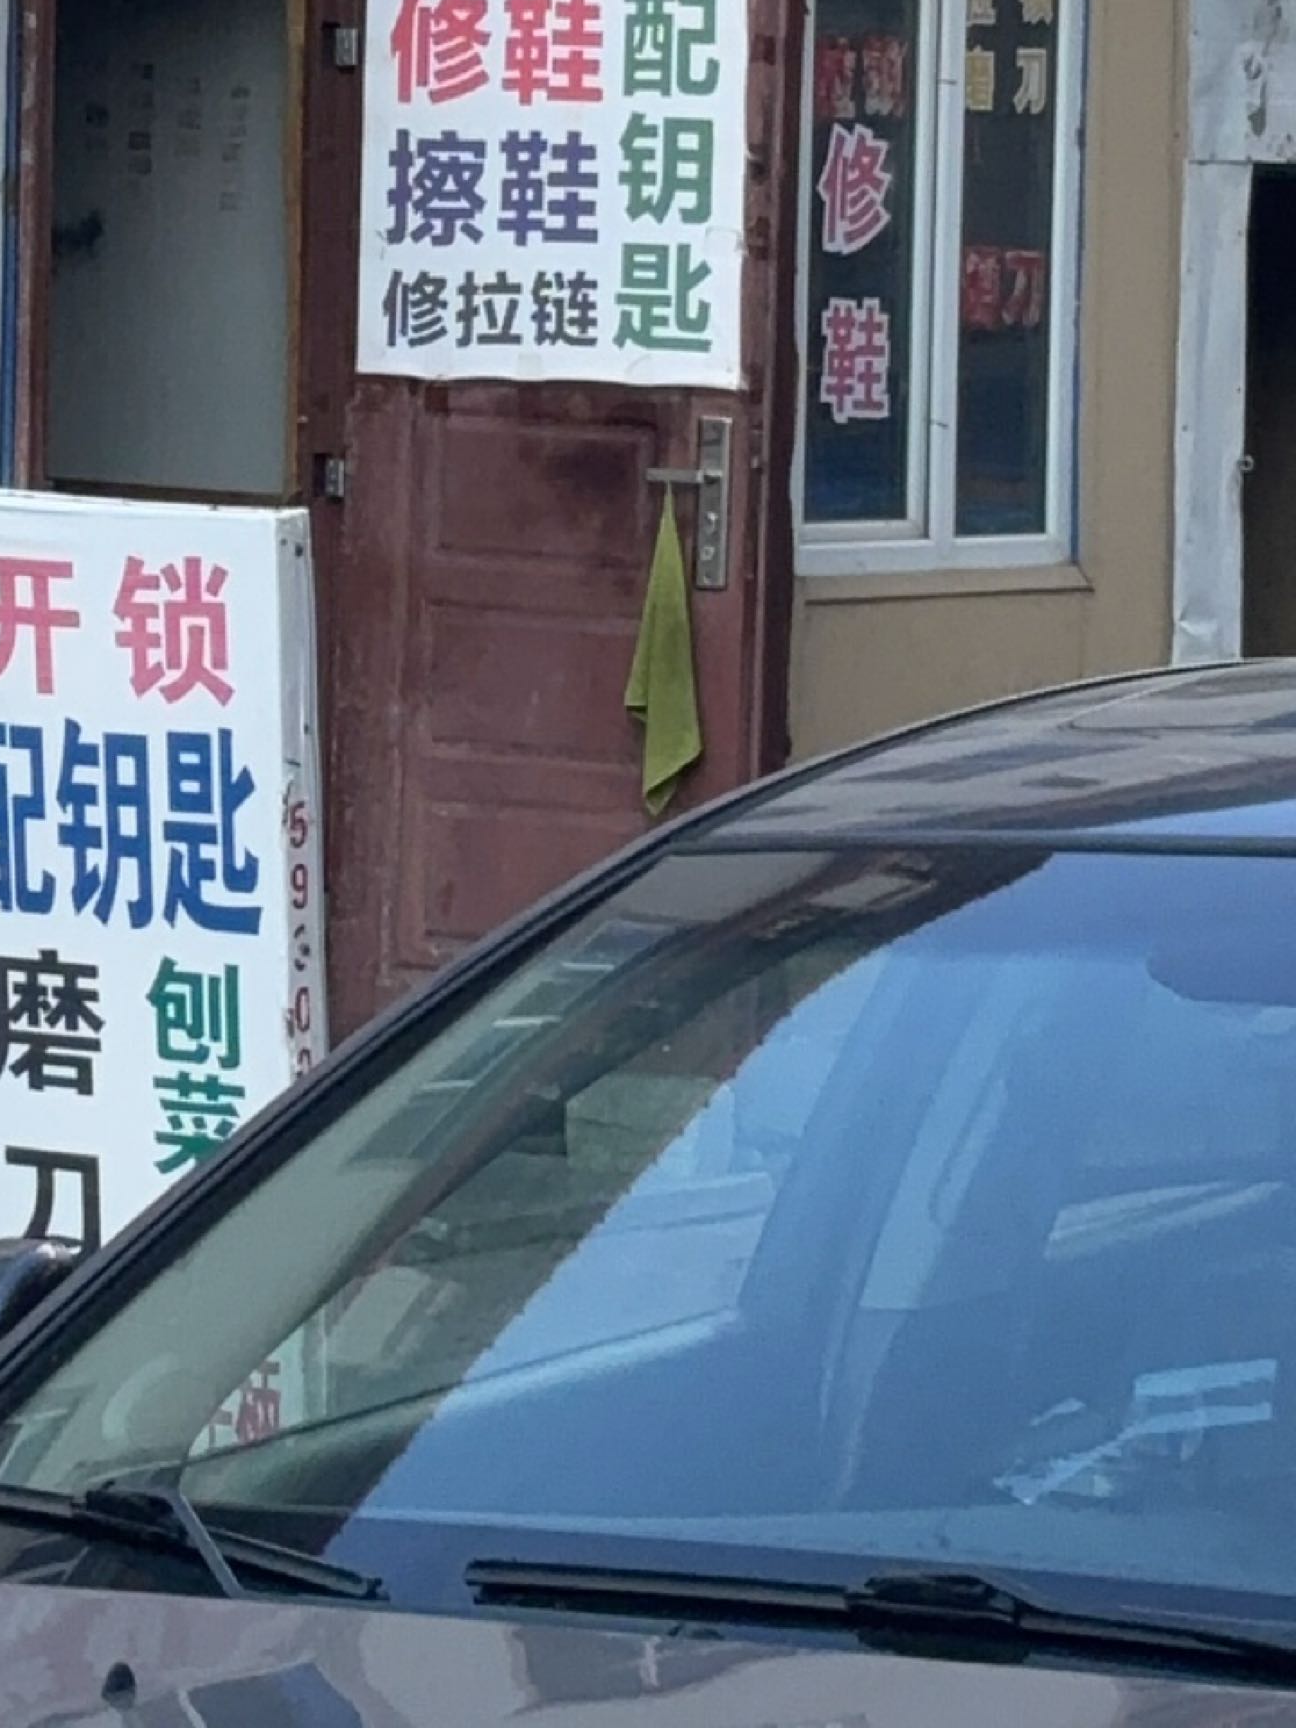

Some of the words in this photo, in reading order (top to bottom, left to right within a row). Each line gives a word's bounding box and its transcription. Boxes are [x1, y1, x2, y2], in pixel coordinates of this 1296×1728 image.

[387, 128, 599, 247] 擦鞋
[382, 269, 598, 348] 修拉链
[817, 123, 892, 423] 修鞋
[145, 955, 246, 1175] 刨菜
